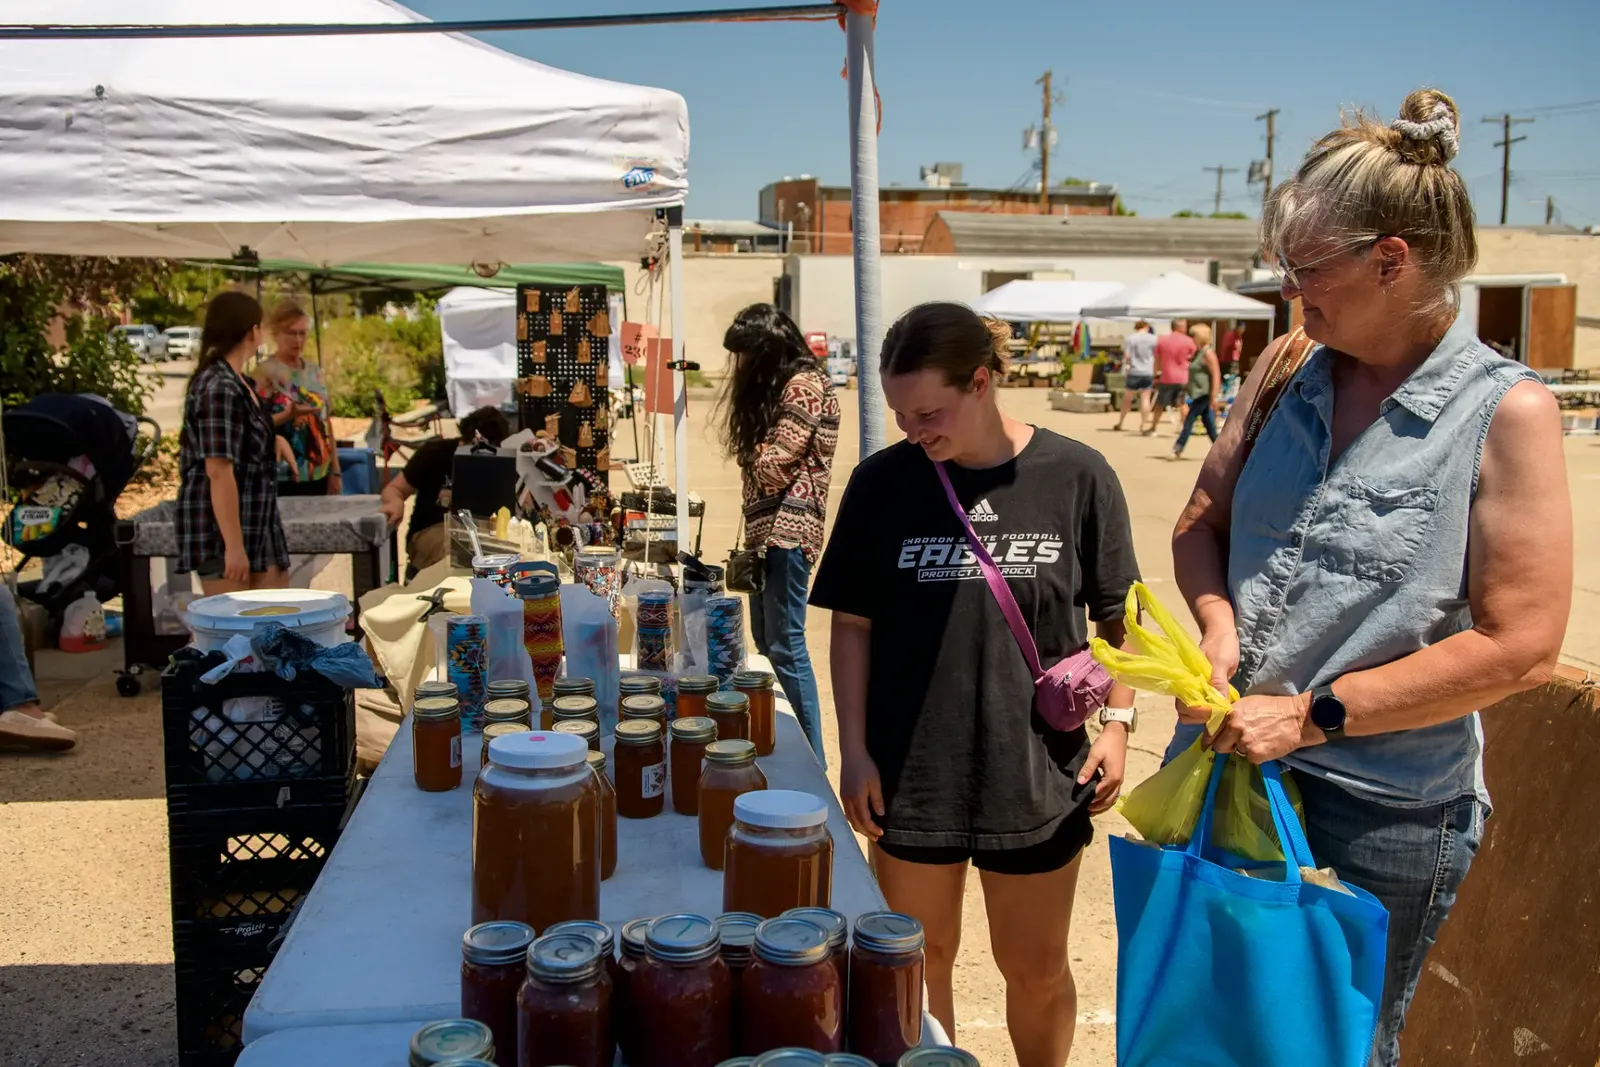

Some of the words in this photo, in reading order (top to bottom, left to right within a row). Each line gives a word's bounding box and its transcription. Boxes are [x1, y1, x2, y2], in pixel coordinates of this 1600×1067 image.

[1267, 357, 1292, 389] Wrangler
[1245, 408, 1263, 441] Wrangler
[902, 536, 955, 546] CHADRON
[958, 534, 998, 543] STE
[1001, 533, 1061, 541] FOOTBALL
[897, 541, 1064, 568] EAGLES
[920, 567, 972, 579] PROTECT
[1000, 567, 1034, 576] ROCK
